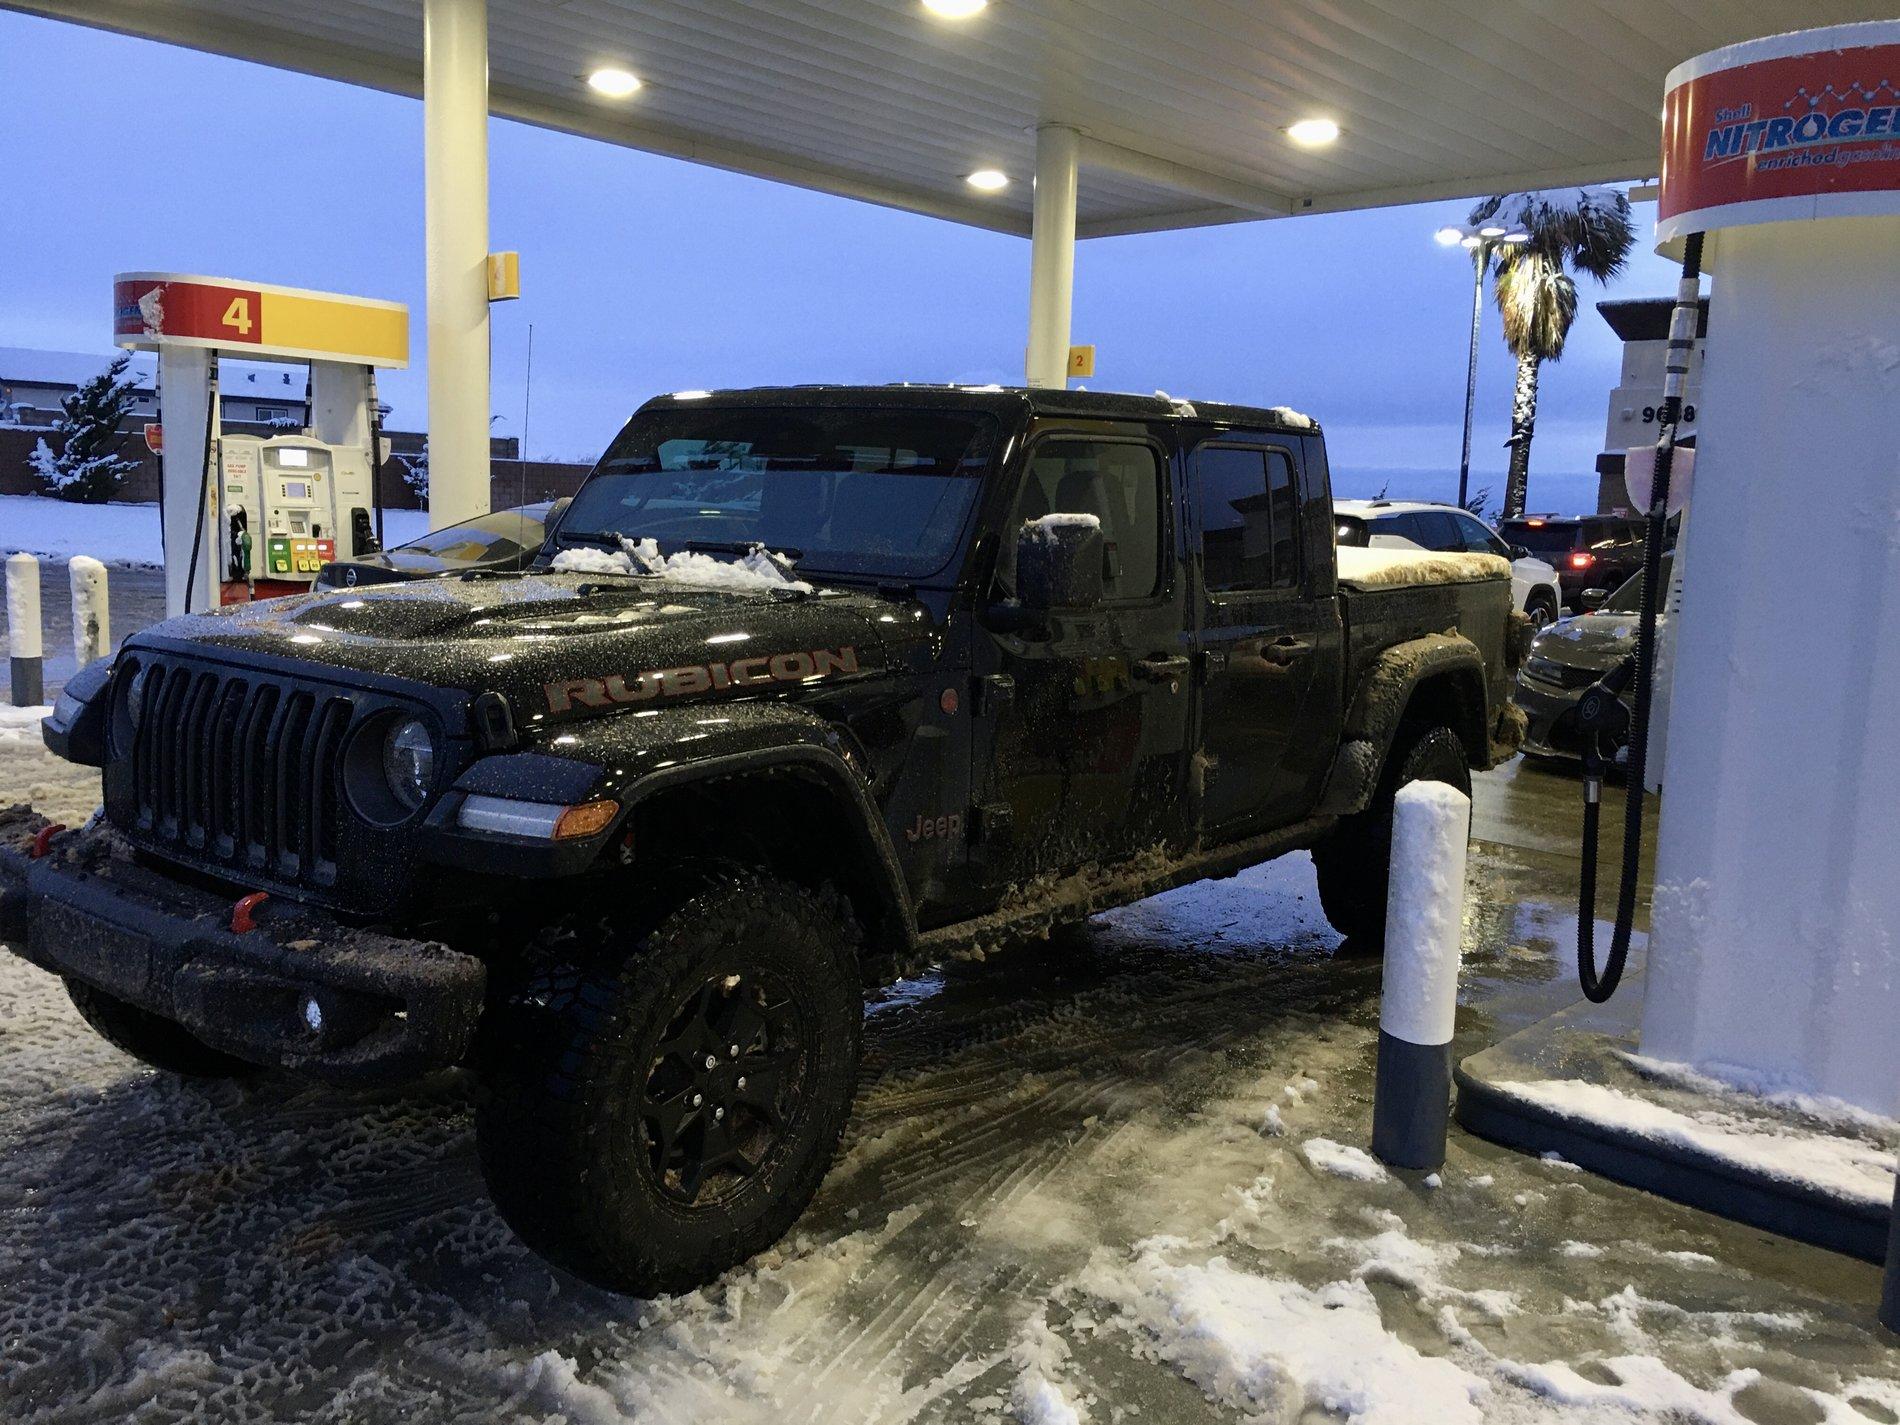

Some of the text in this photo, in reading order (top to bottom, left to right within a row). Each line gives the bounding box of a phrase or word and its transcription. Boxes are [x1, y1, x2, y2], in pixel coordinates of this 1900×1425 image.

[1714, 102, 1752, 123] Shell
[1703, 105, 1900, 162] NITROGE
[1756, 146, 1838, 172] enriched
[221, 297, 252, 335] 4
[1075, 354, 1085, 367] 2
[1642, 405, 1696, 423] 98
[544, 646, 858, 714] RUBICON
[904, 814, 961, 842] Jeep
